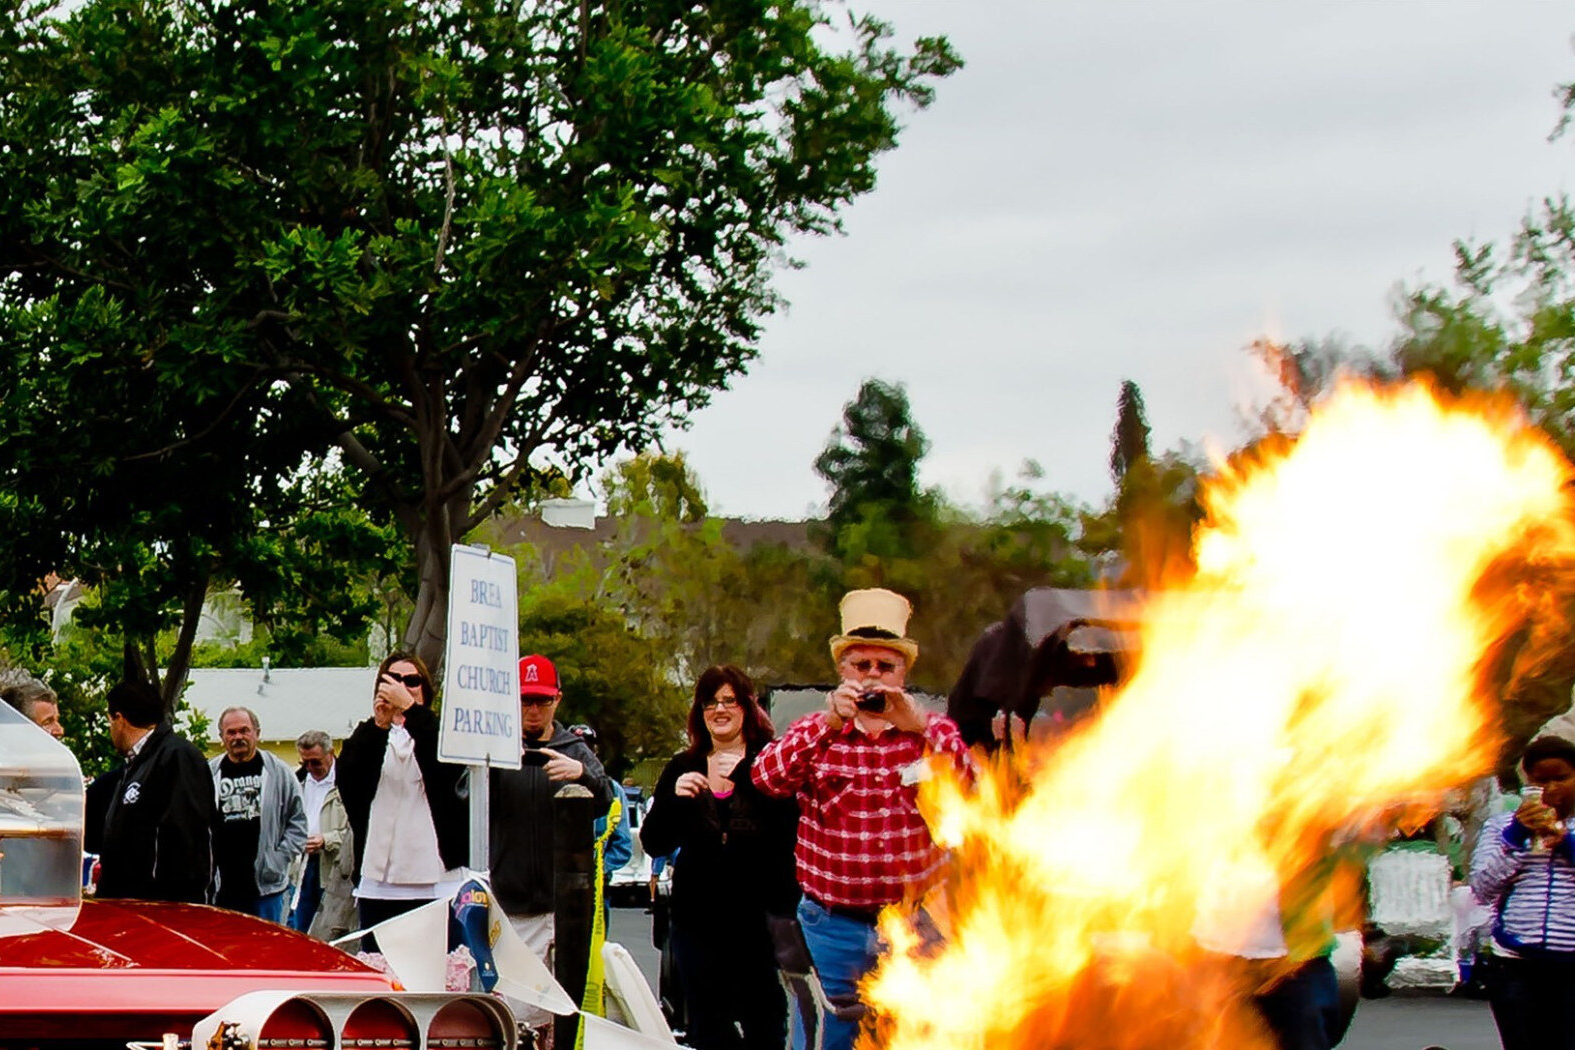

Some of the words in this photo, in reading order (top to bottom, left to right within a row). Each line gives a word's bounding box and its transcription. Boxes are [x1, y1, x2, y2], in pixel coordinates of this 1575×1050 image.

[470, 578, 503, 609] BREA
[460, 620, 510, 654] BAPTIST
[456, 663, 512, 696] CHURCH
[452, 706, 513, 739] PARKING
